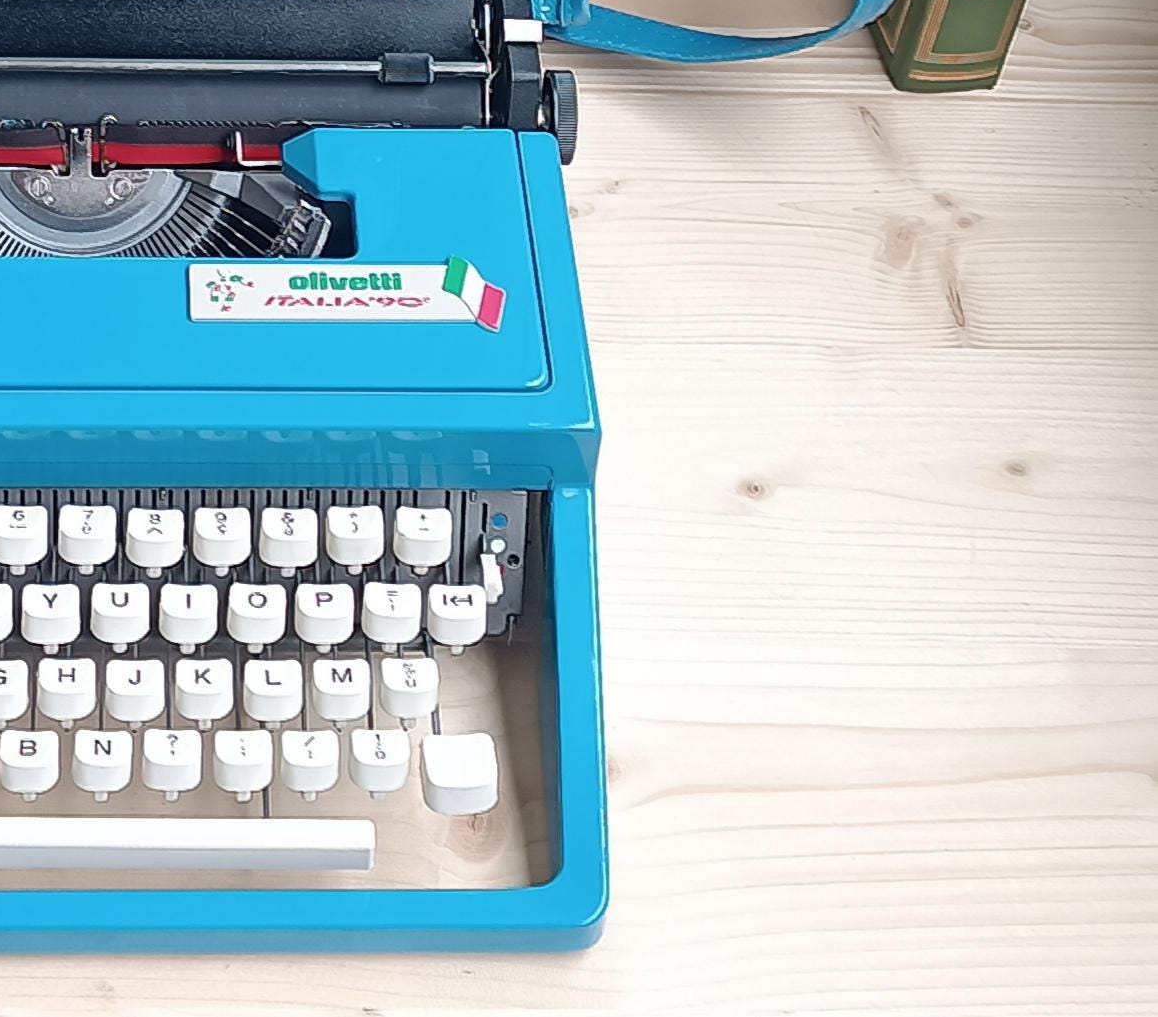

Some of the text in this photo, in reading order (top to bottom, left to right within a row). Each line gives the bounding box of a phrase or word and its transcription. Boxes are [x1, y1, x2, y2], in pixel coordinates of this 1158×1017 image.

[289, 271, 402, 291] olivetti
[42, 592, 58, 609] Y
[110, 591, 129, 608] U
[247, 591, 268, 609] O
[315, 591, 334, 608] P
[57, 667, 76, 683] H
[128, 669, 141, 686] J
[194, 667, 212, 685] K
[264, 669, 283, 686] L
[331, 667, 353, 683] M
[19, 739, 37, 757] B
[94, 739, 112, 756] N
